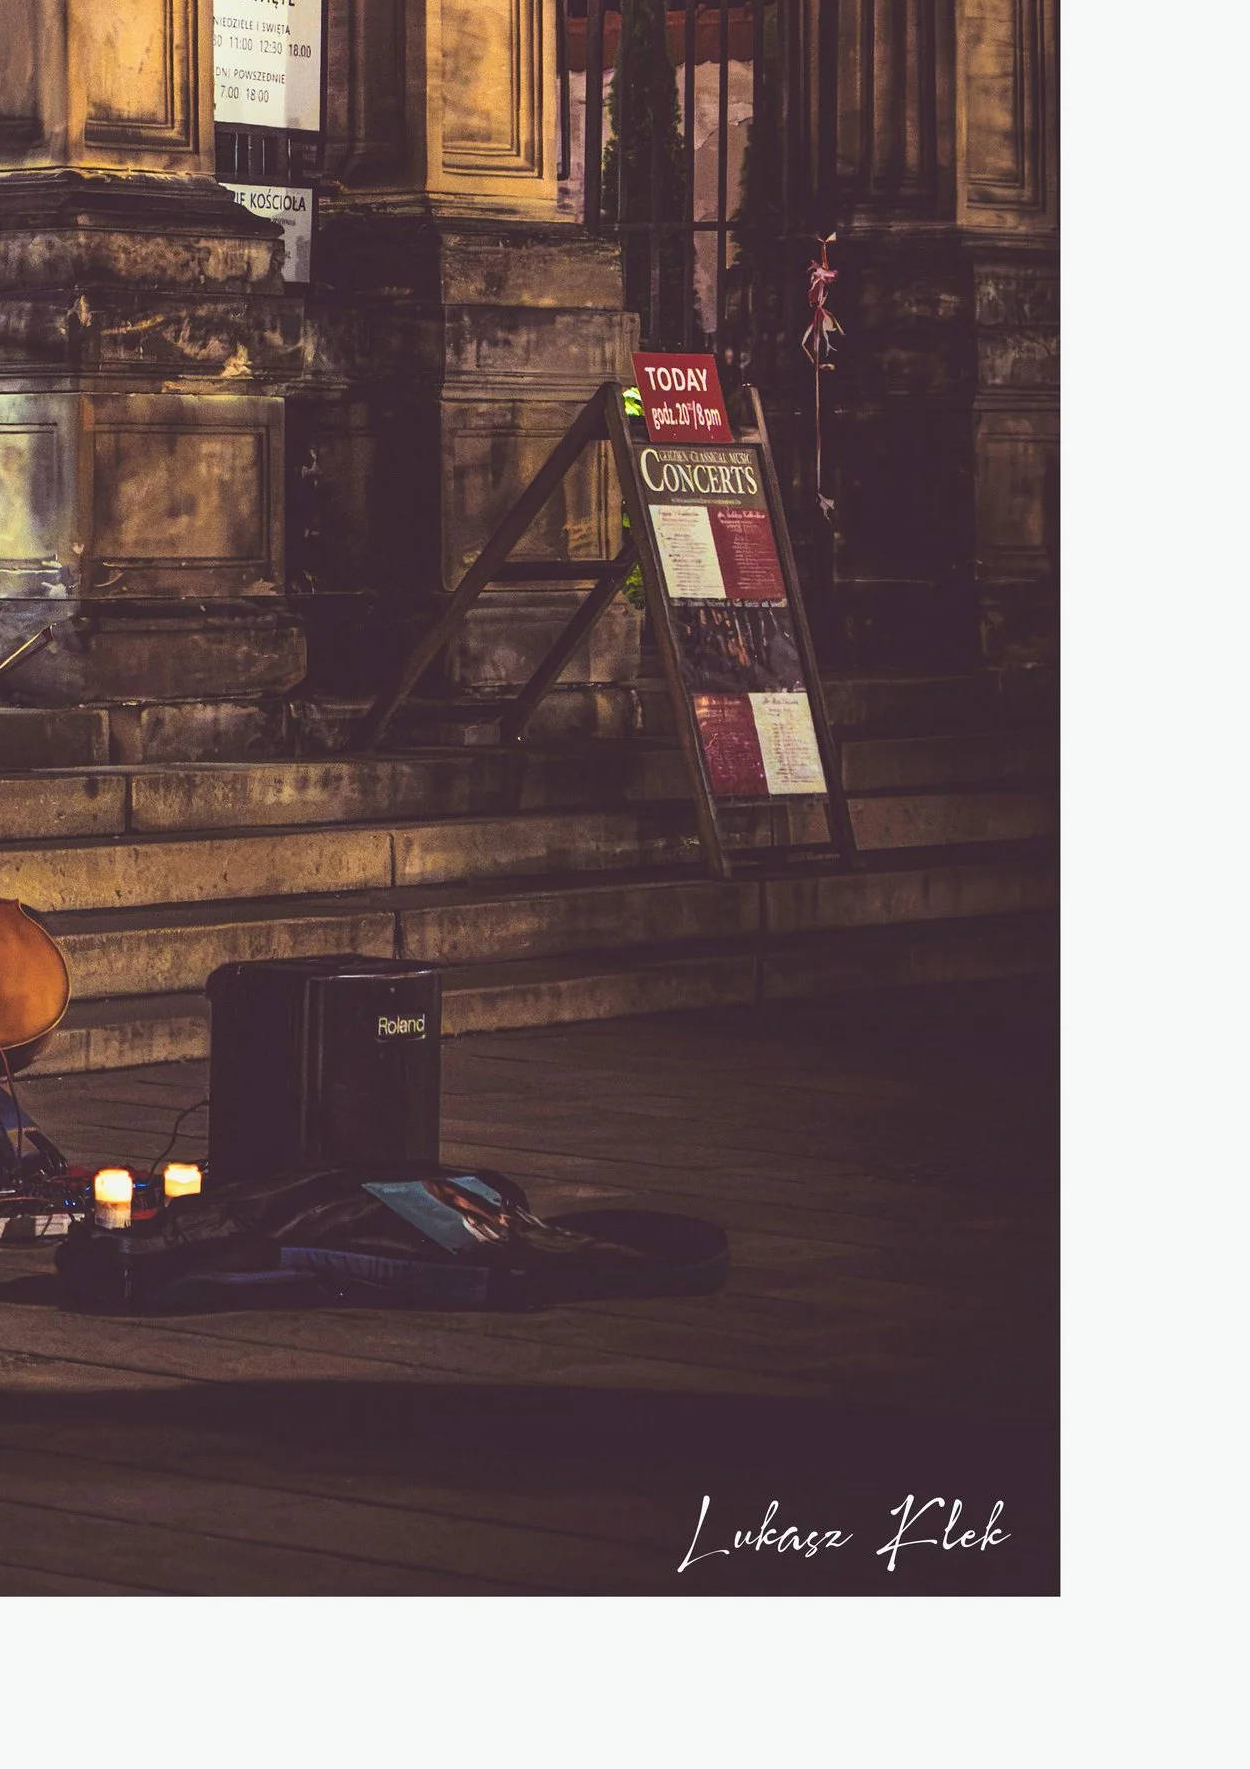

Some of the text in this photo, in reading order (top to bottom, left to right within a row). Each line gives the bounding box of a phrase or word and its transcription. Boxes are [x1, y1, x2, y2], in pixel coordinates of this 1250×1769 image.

[230, 37, 253, 51] 11:00
[260, 40, 283, 55] 12:30
[289, 44, 311, 58] 18.00
[234, 68, 285, 84] POWSZEDNIE
[250, 188, 306, 211] KOŚCIOŁA
[644, 367, 707, 391] TODAY
[640, 448, 758, 495] CONCERTS
[378, 1013, 425, 1036] Roland
